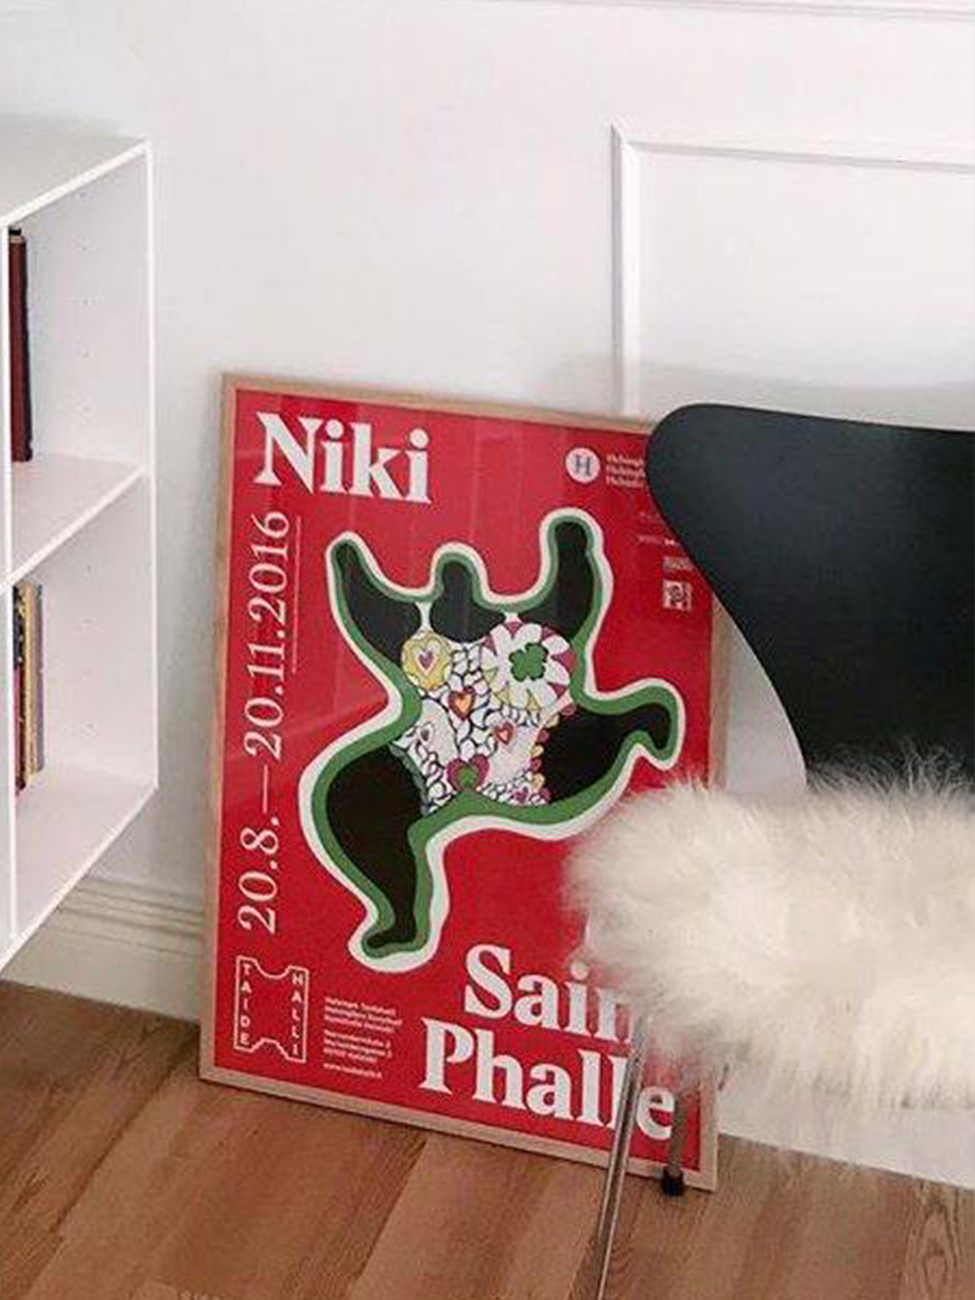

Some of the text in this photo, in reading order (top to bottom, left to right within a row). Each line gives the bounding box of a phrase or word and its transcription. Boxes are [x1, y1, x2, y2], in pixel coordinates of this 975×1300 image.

[254, 411, 431, 504] Niki
[238, 510, 290, 936] 20.8. 20.11.2016
[239, 962, 252, 1047] TAIDE
[289, 970, 303, 1057] HALLI
[463, 943, 637, 1045] Sain
